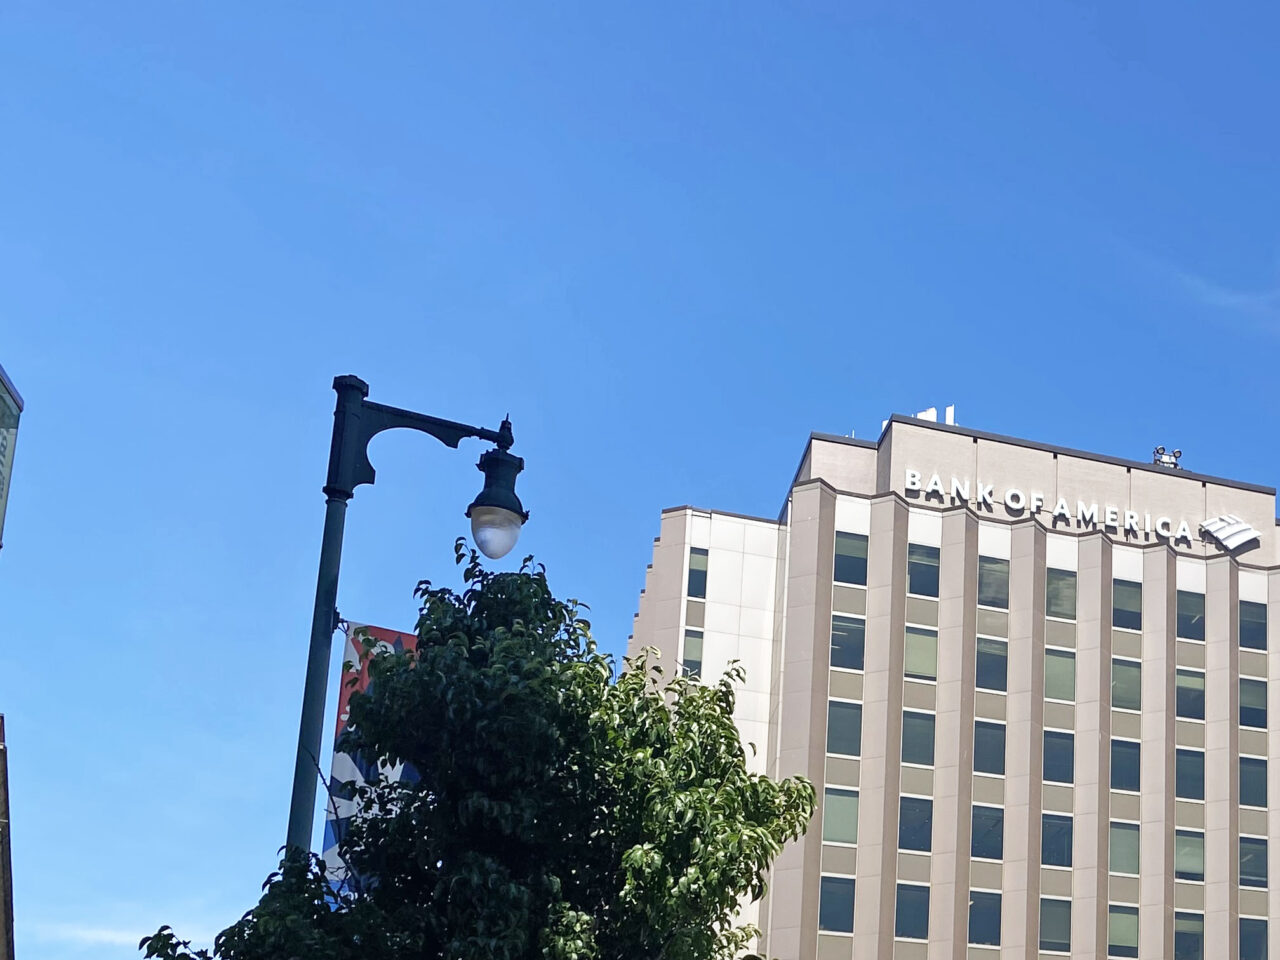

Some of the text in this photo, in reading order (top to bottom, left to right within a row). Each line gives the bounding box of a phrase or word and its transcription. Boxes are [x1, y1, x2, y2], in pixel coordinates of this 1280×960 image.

[905, 468, 1194, 542] BANK OF AMERICA
